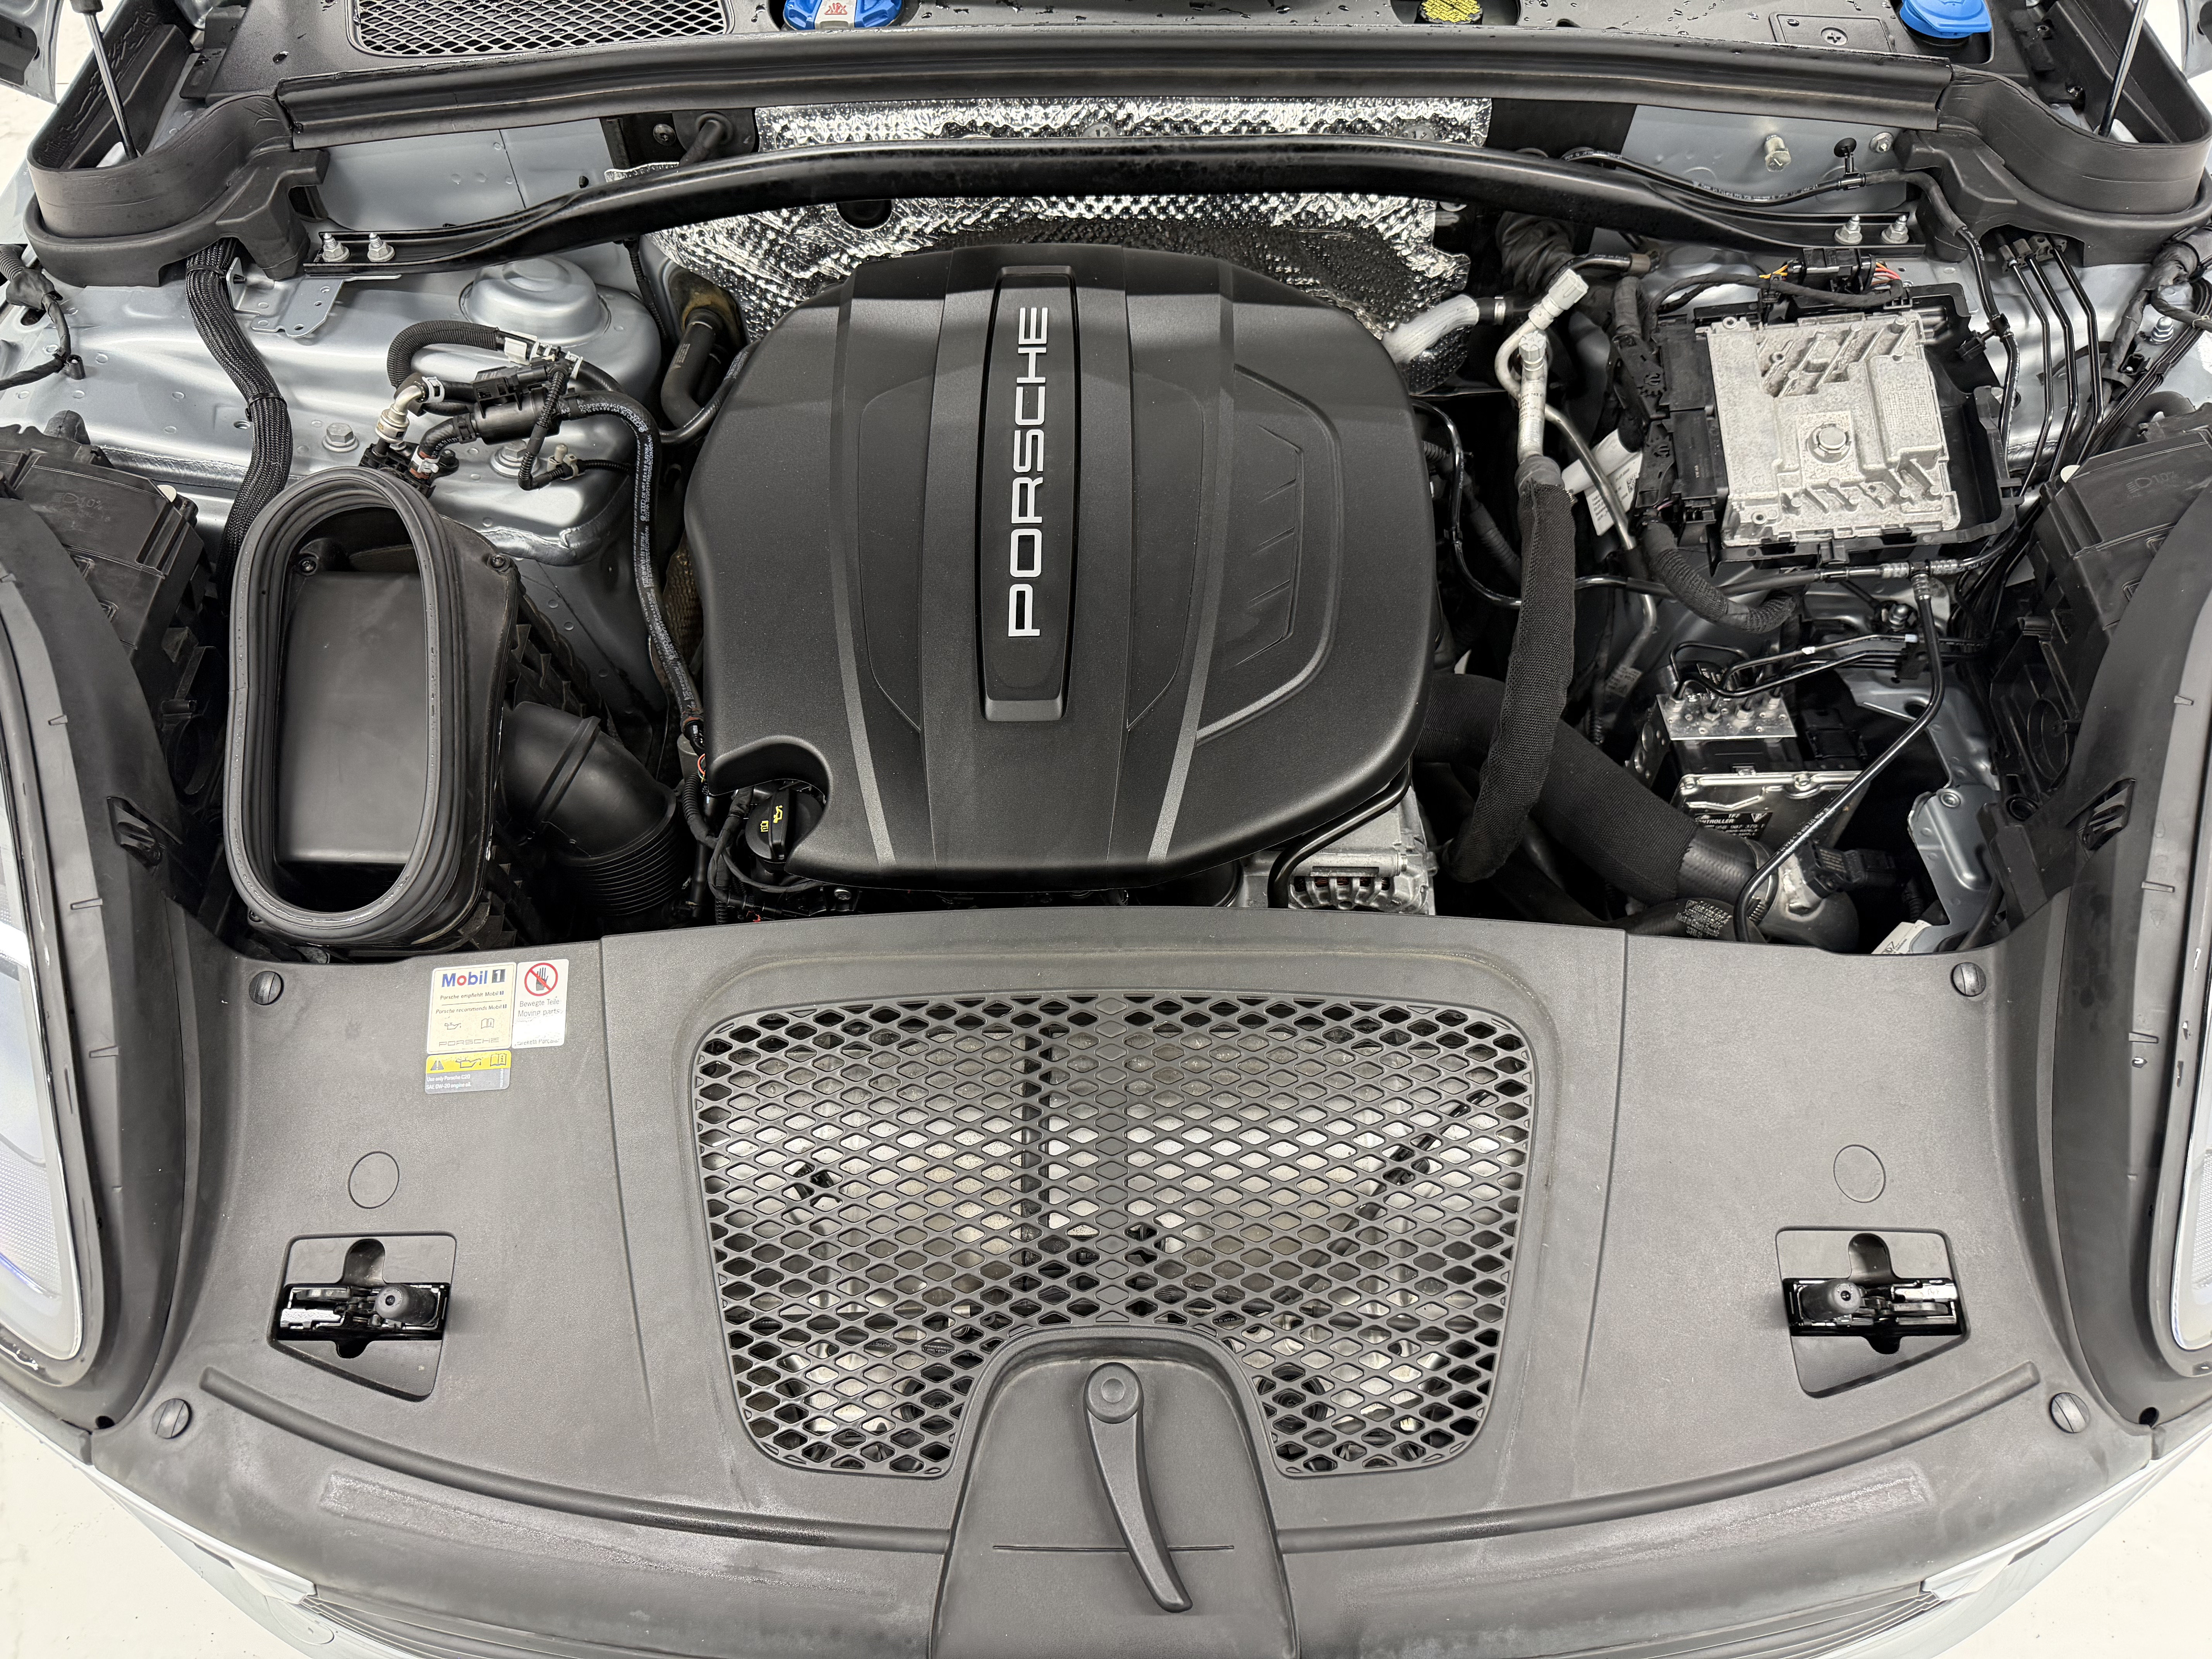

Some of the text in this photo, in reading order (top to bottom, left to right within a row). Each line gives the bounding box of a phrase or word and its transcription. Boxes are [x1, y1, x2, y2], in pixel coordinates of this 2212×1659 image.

[1008, 307, 1048, 637] PORSCHE
[441, 969, 503, 987] Mobil 1
[439, 1037, 499, 1046] PORSCHE
